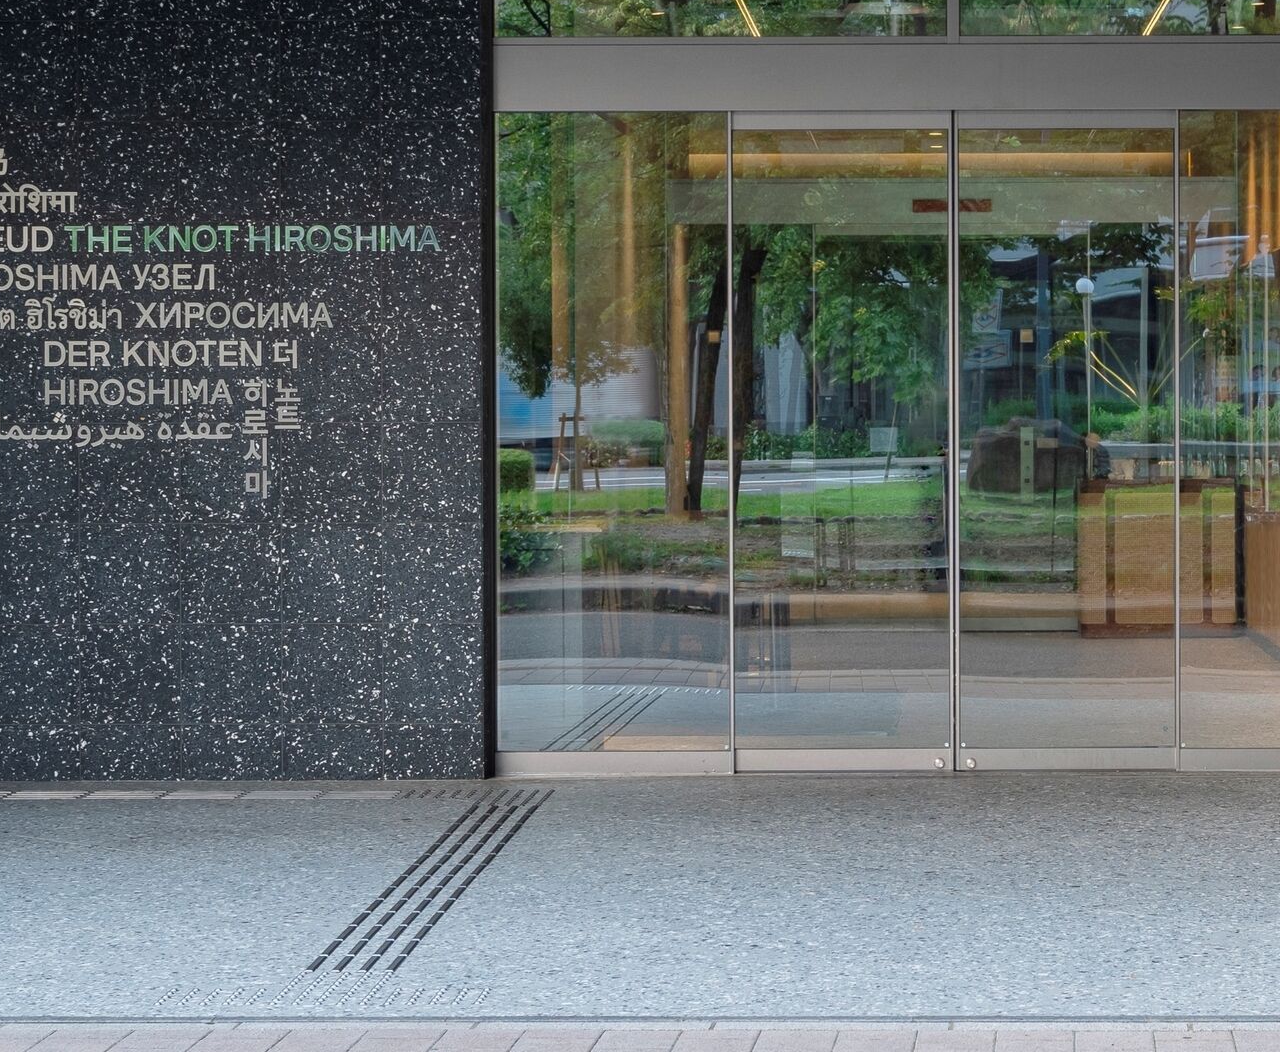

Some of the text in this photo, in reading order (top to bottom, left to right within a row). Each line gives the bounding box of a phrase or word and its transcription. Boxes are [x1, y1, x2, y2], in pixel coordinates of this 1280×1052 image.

[64, 225, 442, 253] THE KNOT HIROSHIMA
[133, 264, 216, 291] УЗЕЛ
[135, 302, 334, 329] ХИРОСИМА
[43, 340, 262, 367] DER KNOTEN
[273, 339, 298, 369] 더
[43, 378, 234, 405] HIROSHIMA
[156, 411, 233, 441] عقدة
[242, 378, 269, 499] 히로시마
